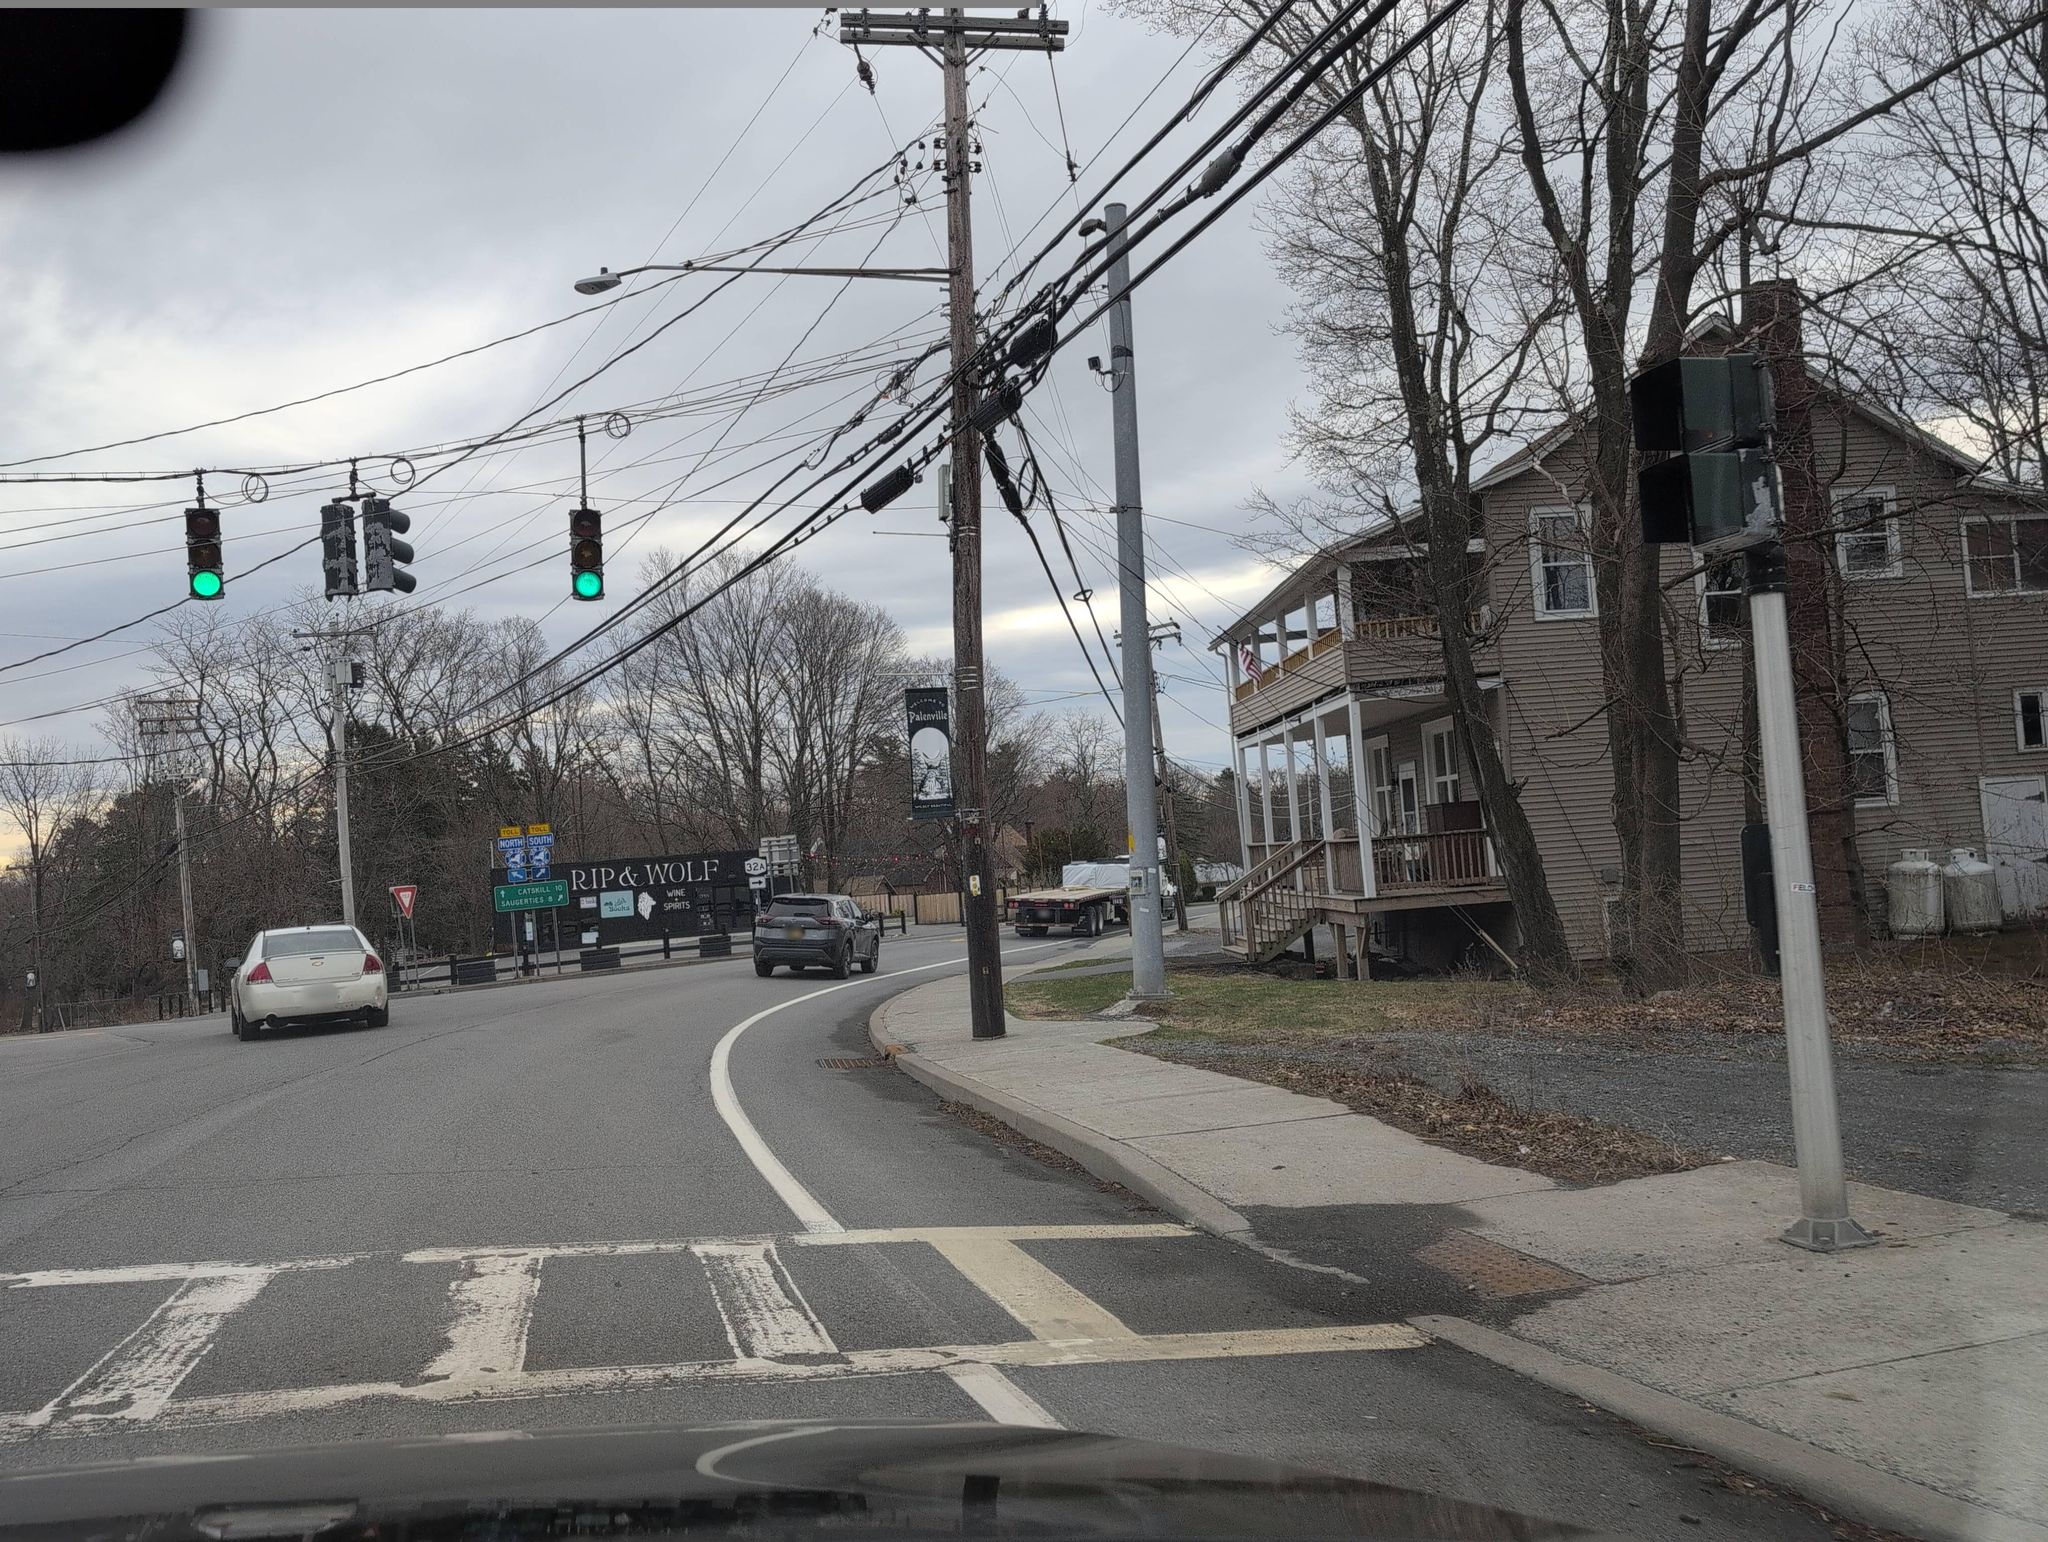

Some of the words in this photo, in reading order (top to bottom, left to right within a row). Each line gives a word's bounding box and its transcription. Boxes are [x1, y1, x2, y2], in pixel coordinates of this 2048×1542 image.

[908, 710, 948, 723] Palenville
[530, 825, 547, 833] TOLL
[500, 838, 523, 848] NORTH
[529, 834, 552, 845] SOUTH
[746, 862, 765, 872] 32A
[571, 867, 615, 890] RIP
[618, 865, 645, 887] &
[644, 859, 719, 885] WOLF
[517, 885, 551, 896] CATSKILL
[666, 888, 686, 897] WINE
[501, 896, 544, 907] SAUGERTIES
[663, 901, 691, 911] SPIRITS
